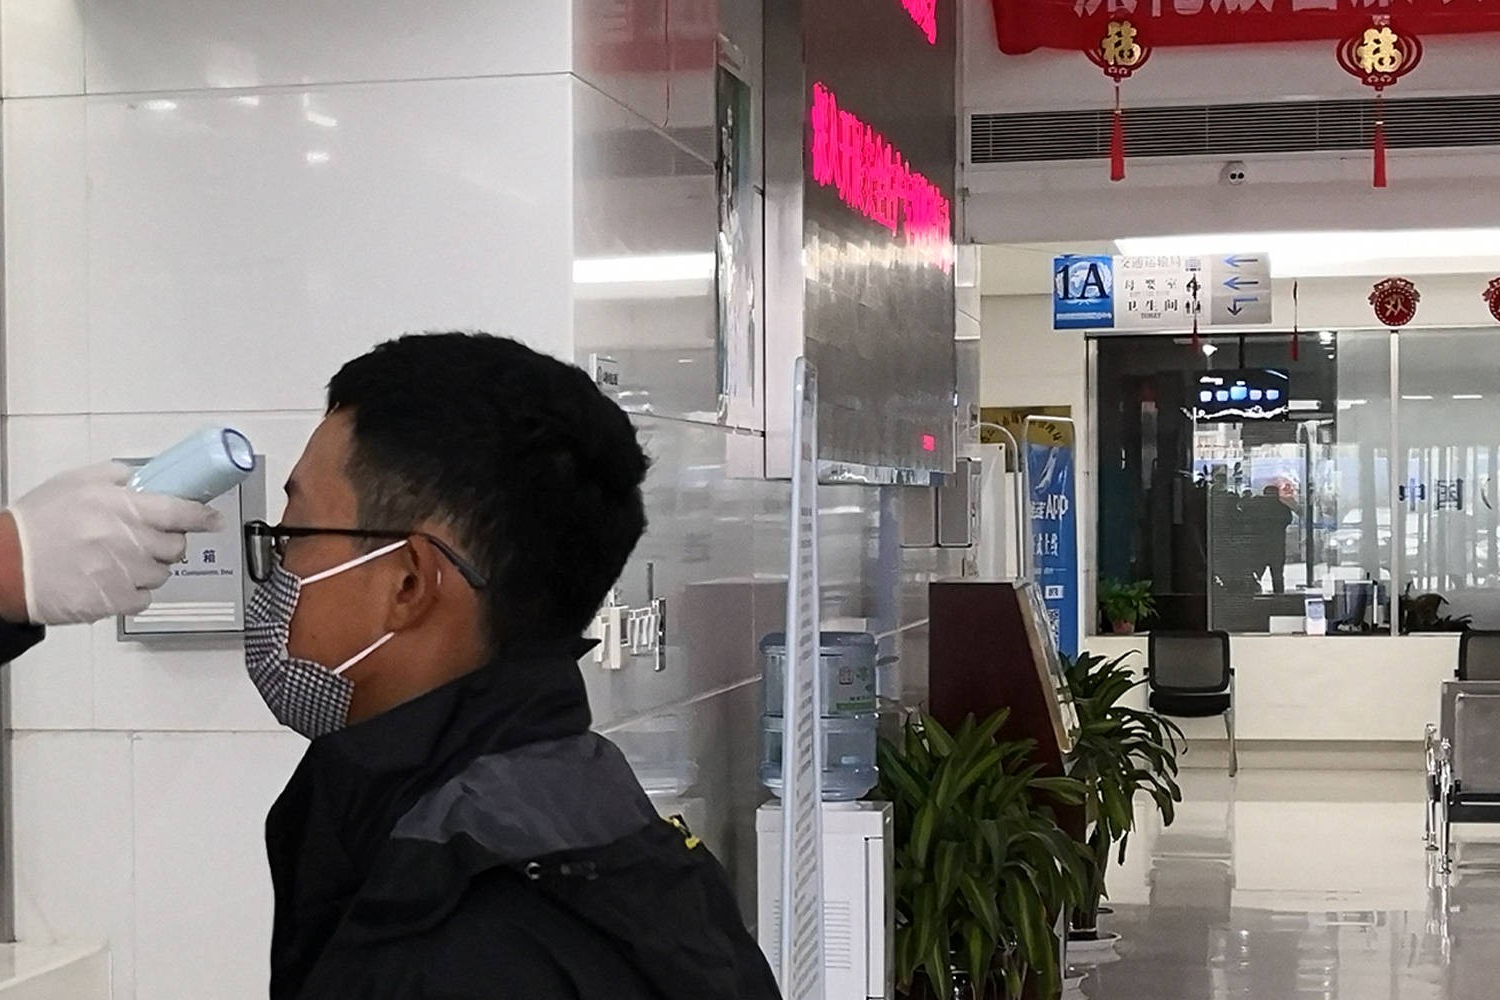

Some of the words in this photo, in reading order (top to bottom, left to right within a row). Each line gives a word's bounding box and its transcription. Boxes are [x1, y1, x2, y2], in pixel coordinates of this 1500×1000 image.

[1102, 21, 1141, 65] 福
[1357, 27, 1402, 73] 福
[1056, 263, 1110, 300] 1A
